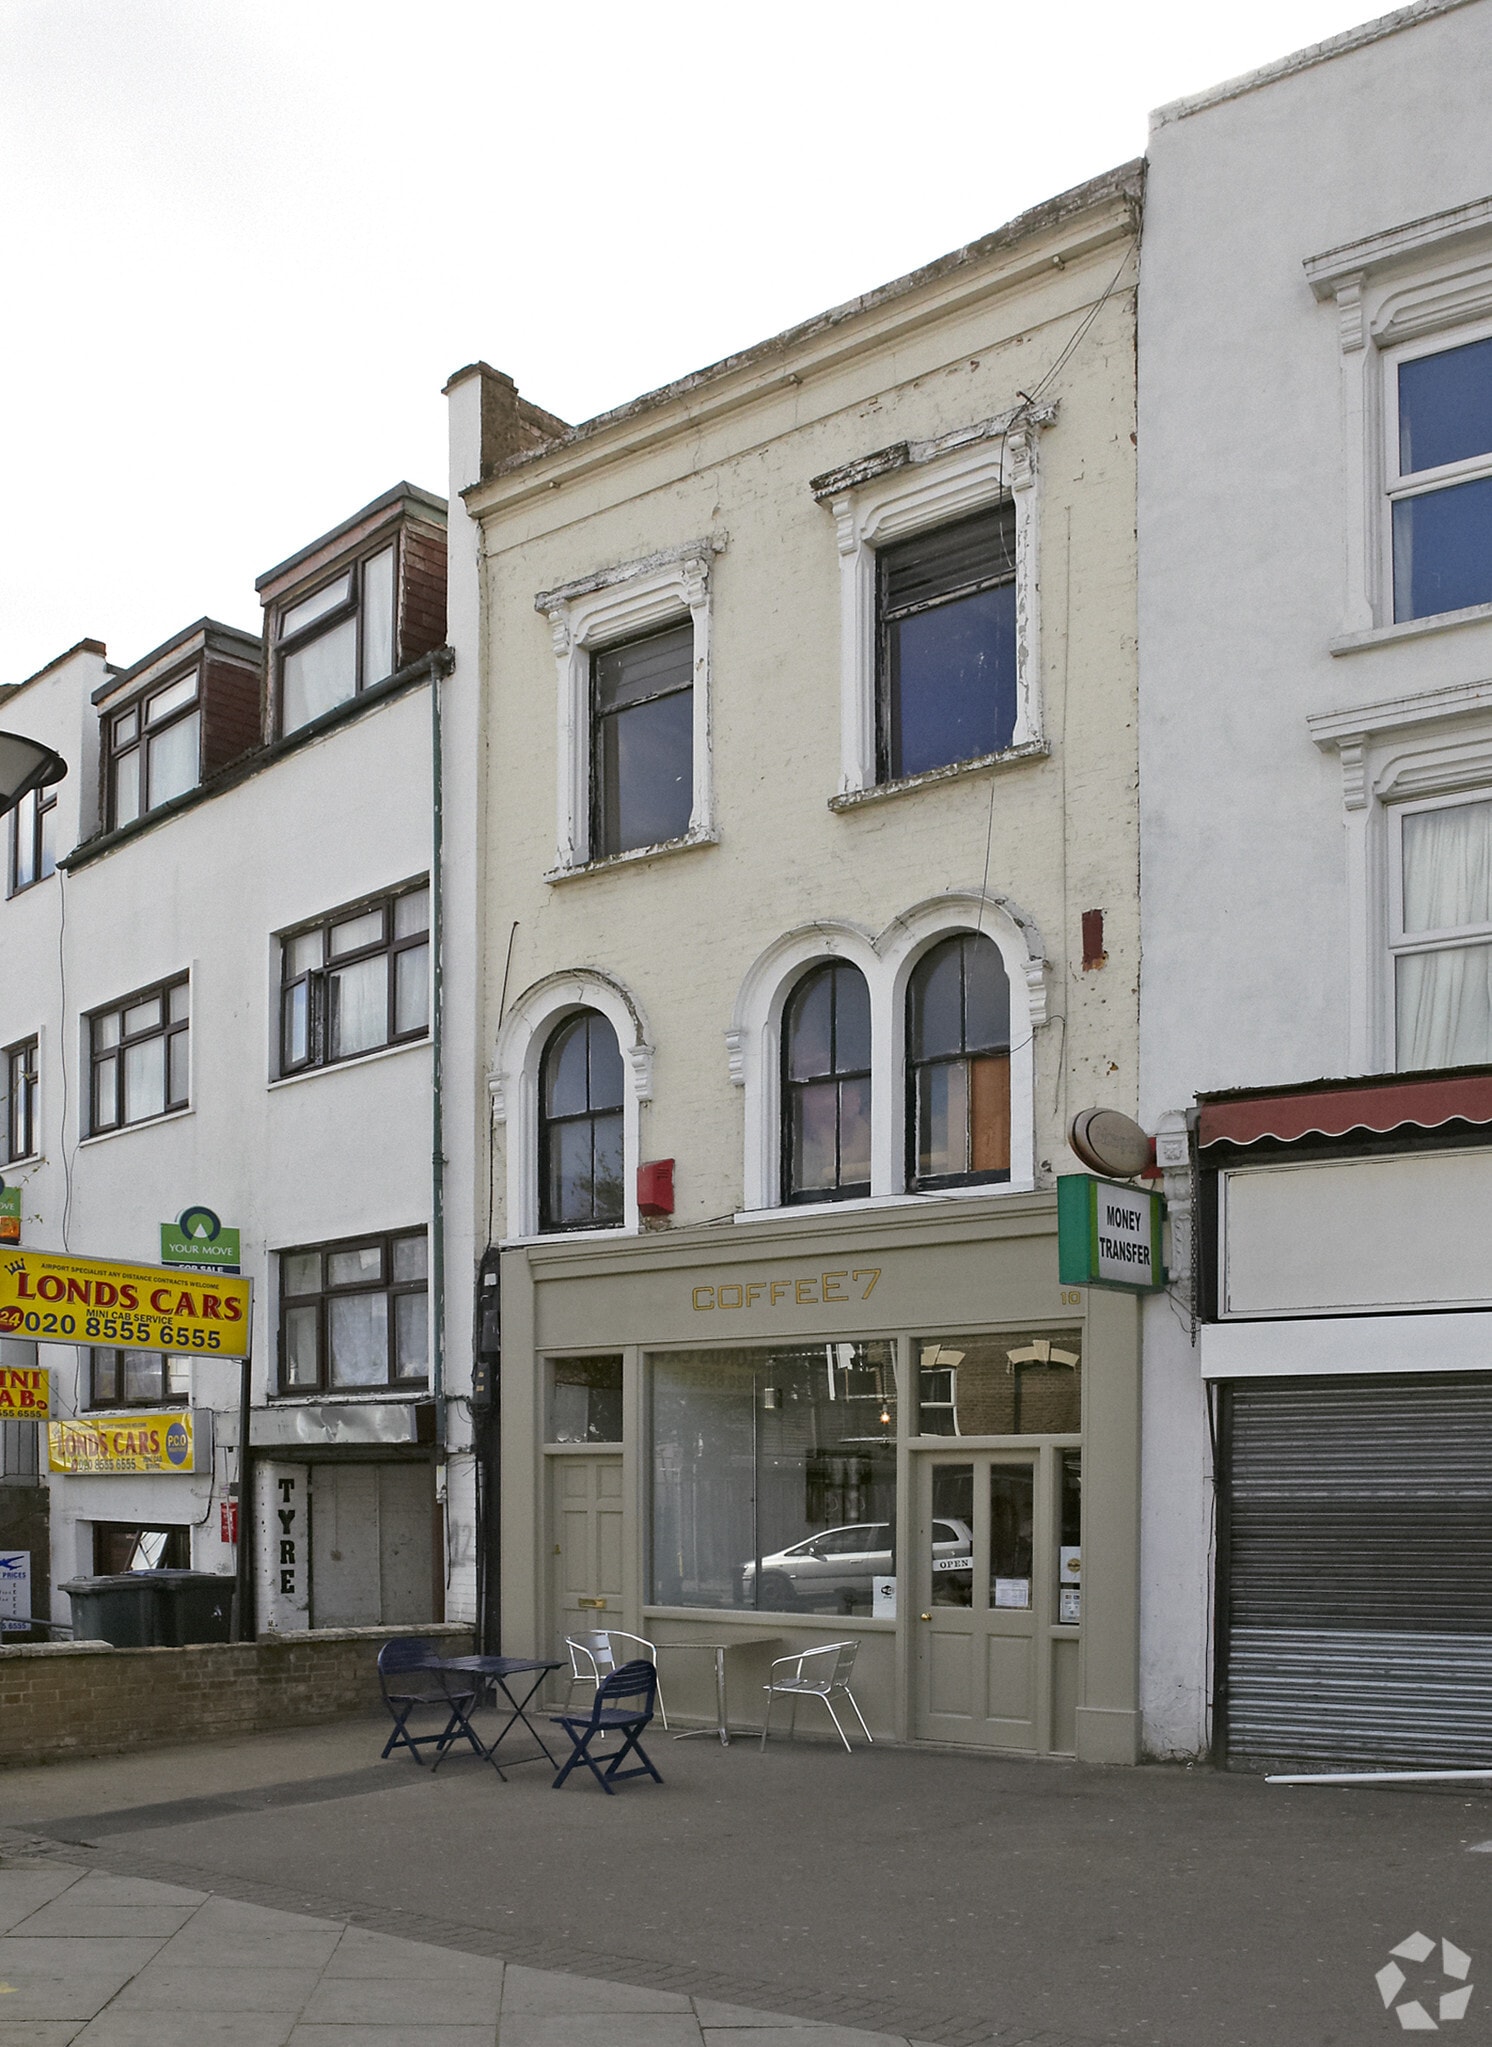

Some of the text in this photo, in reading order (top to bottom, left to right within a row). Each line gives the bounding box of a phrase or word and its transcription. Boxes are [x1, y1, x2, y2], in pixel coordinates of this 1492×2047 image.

[1106, 1205, 1141, 1232] MONEY
[169, 1243, 233, 1257] YOUR MOVE
[1099, 1236, 1151, 1266] TRANSFER
[41, 1263, 70, 1272] AIRPORT
[71, 1267, 107, 1277] SPECIALIST
[122, 1272, 152, 1282] DISTANCE
[153, 1276, 188, 1286] CONTRACTS
[189, 1281, 219, 1290] WELCOME
[16, 1271, 242, 1324] LONDS CARS
[1060, 1291, 1081, 1306] 10
[86, 1309, 174, 1325] MINI CAB SERVICE
[0, 1310, 221, 1349] 24 020 8555 6555
[0, 1370, 41, 1389] INI
[0, 1389, 36, 1408] AB
[17, 1409, 42, 1418] 6555
[56, 1429, 161, 1458] LONDS CARS
[116, 1457, 137, 1470] 6555
[278, 1478, 295, 1594] TYRE
[939, 1559, 969, 1569] OPEN
[2, 1571, 26, 1579] PRICES
